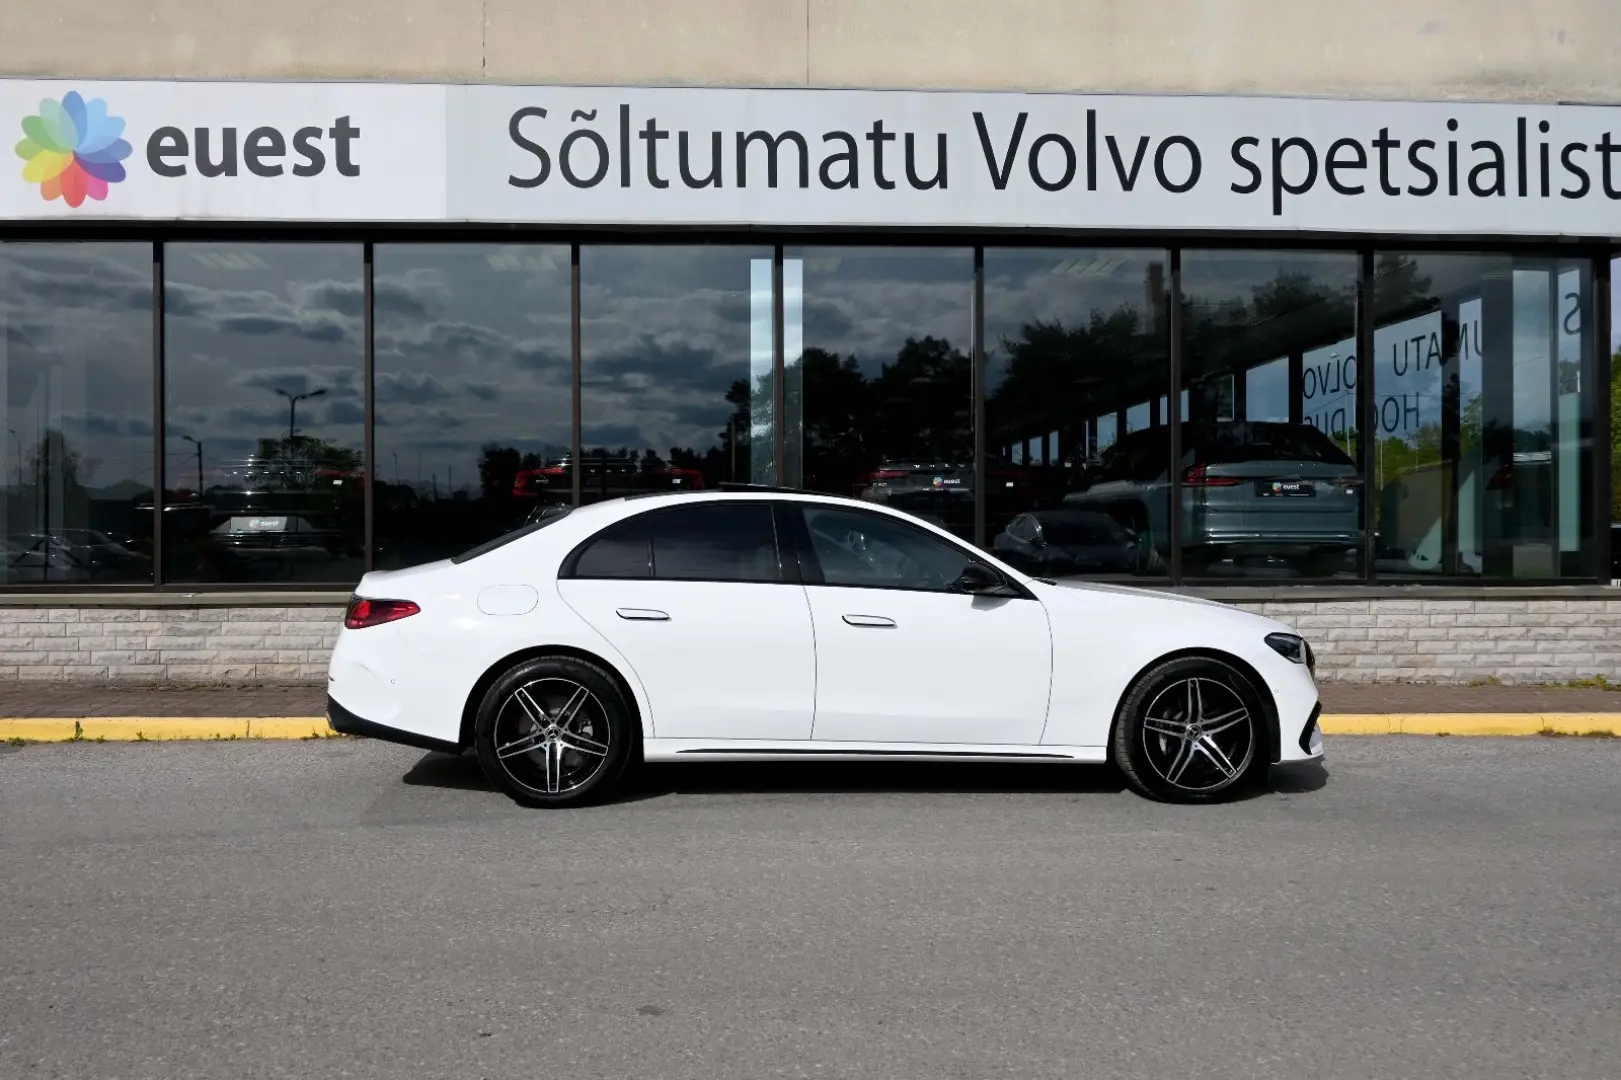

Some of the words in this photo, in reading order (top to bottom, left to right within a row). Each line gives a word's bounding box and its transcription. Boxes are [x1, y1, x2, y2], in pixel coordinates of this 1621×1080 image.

[147, 115, 360, 178] euest
[508, 103, 948, 191] Sõltumatu
[972, 108, 1202, 194] Volvo
[1230, 116, 1621, 216] spetsialist
